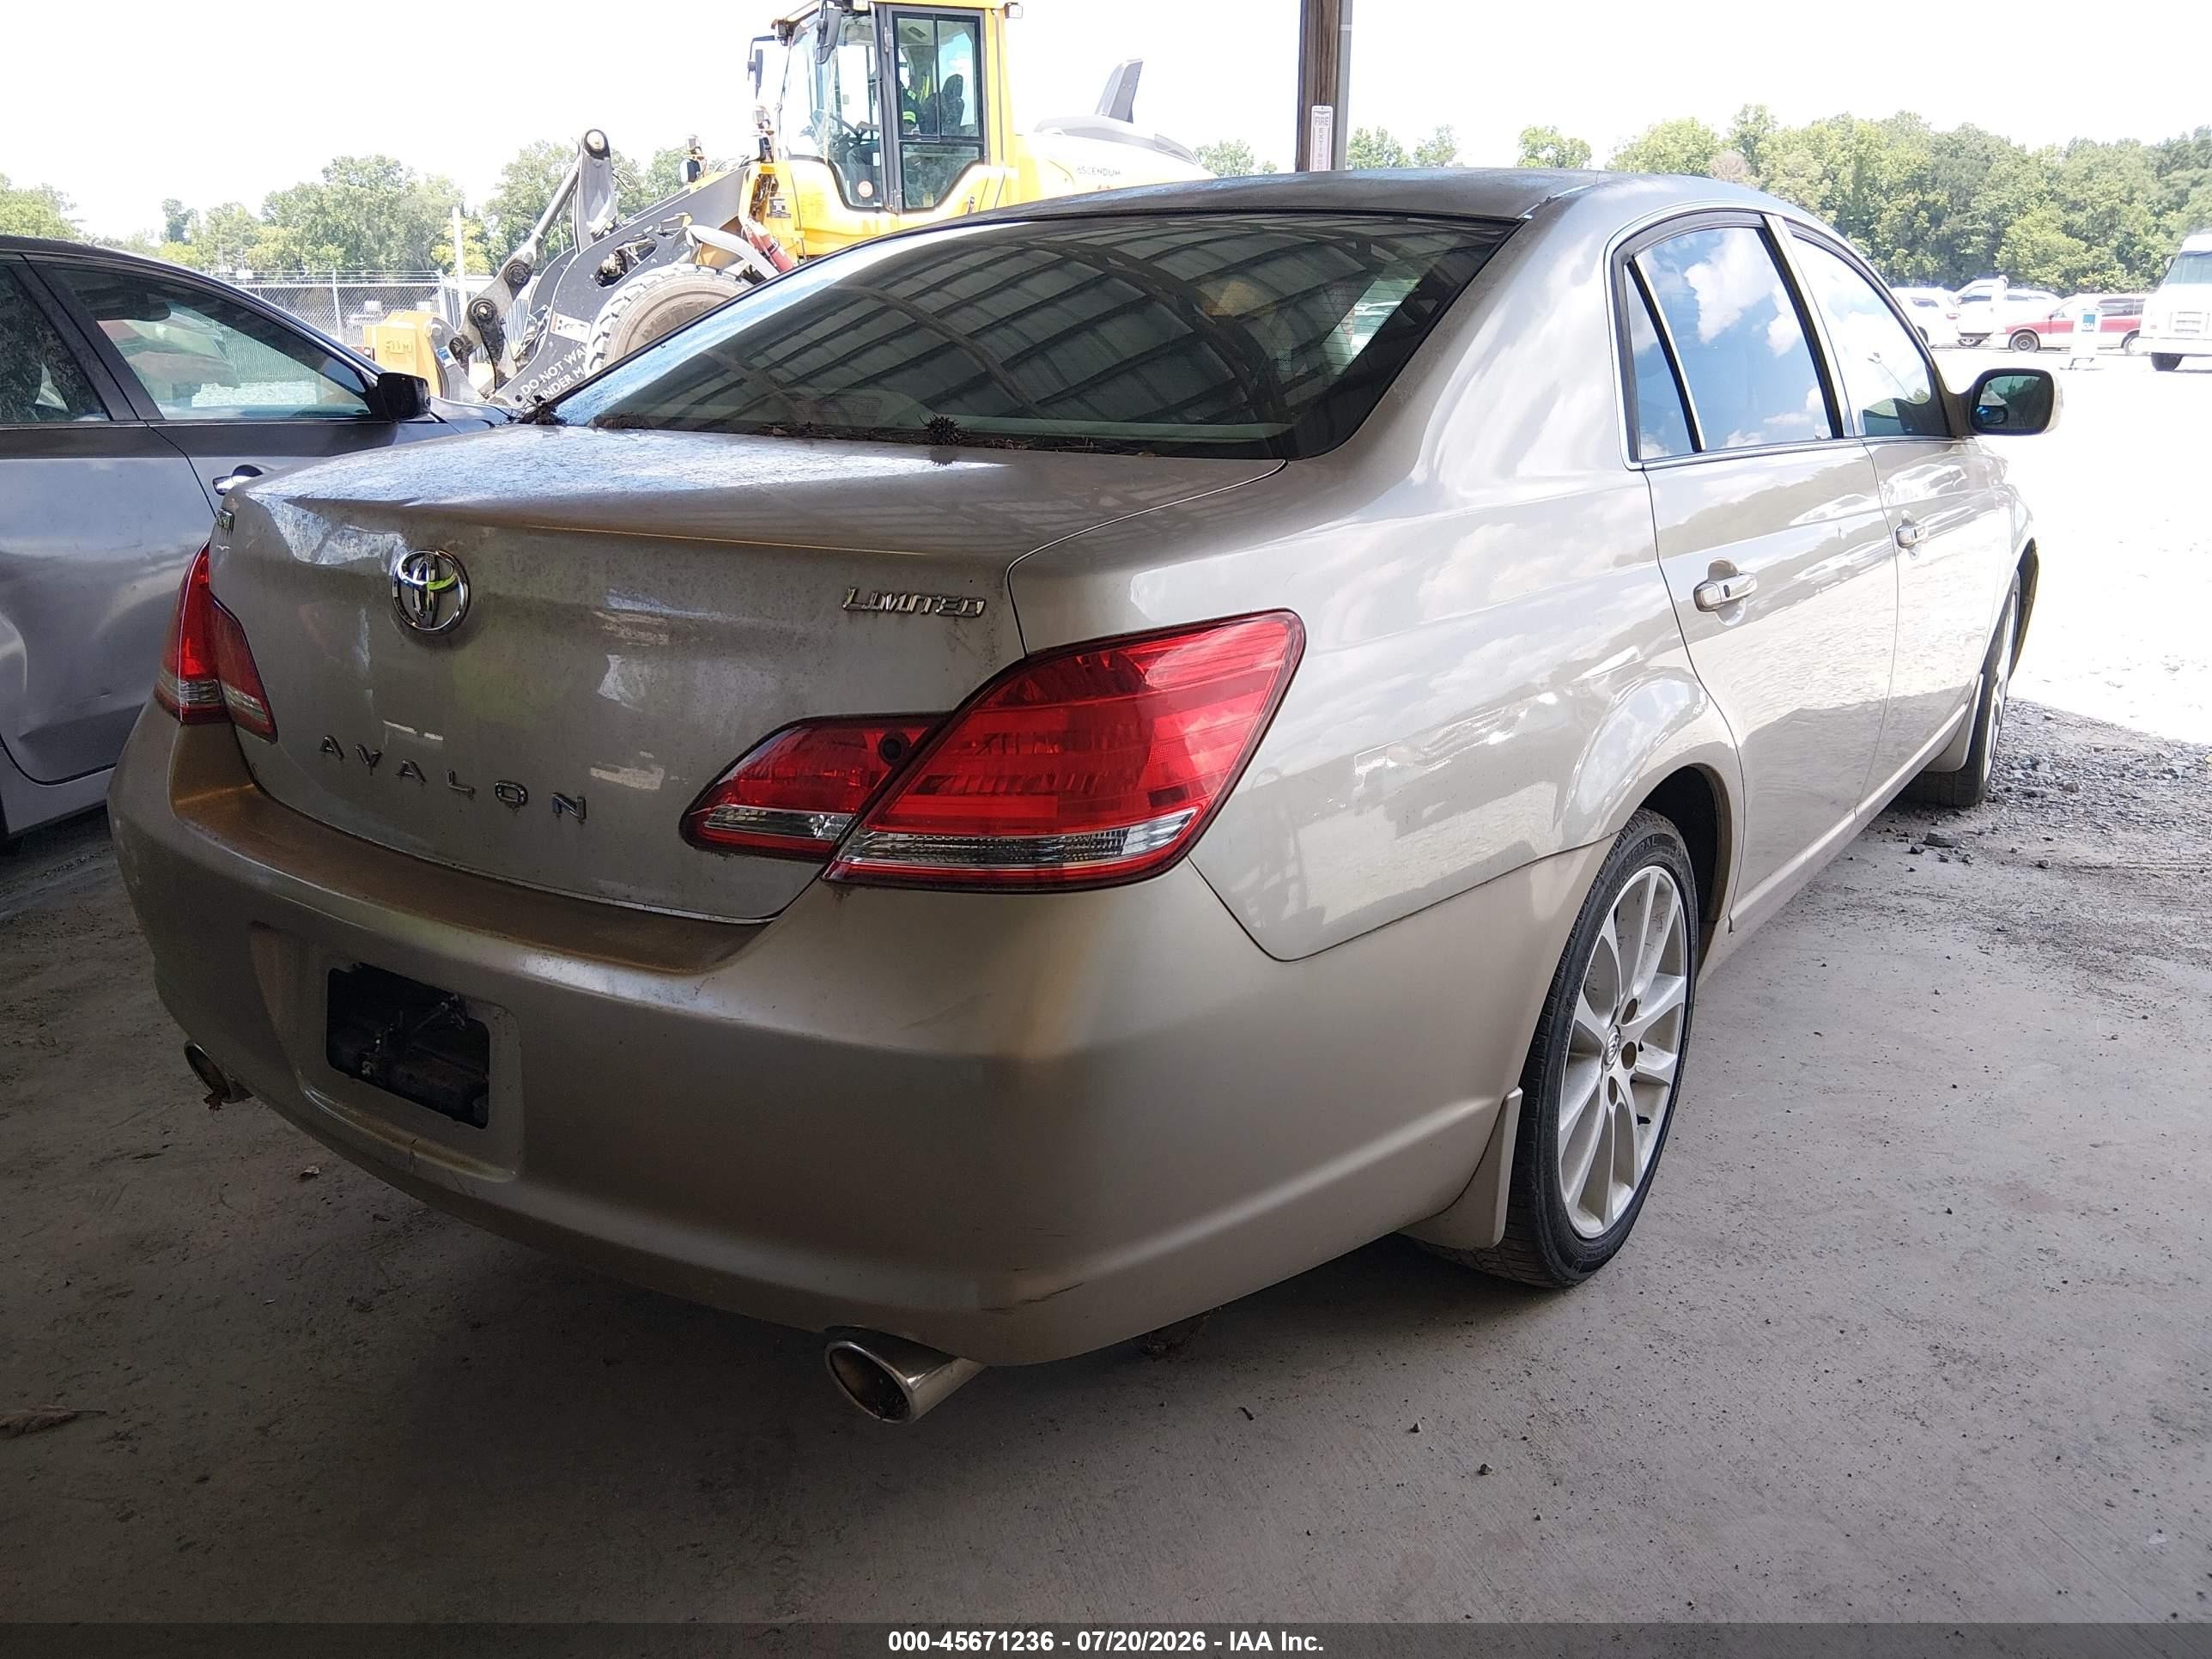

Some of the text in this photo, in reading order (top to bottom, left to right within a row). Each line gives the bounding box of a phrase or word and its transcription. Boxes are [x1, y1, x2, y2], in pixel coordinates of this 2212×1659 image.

[1315, 116, 1329, 126] FIRE
[520, 379, 539, 394] DO
[539, 362, 563, 383] NOT
[842, 587, 987, 617] LIMITED
[319, 735, 586, 819] AVALON
